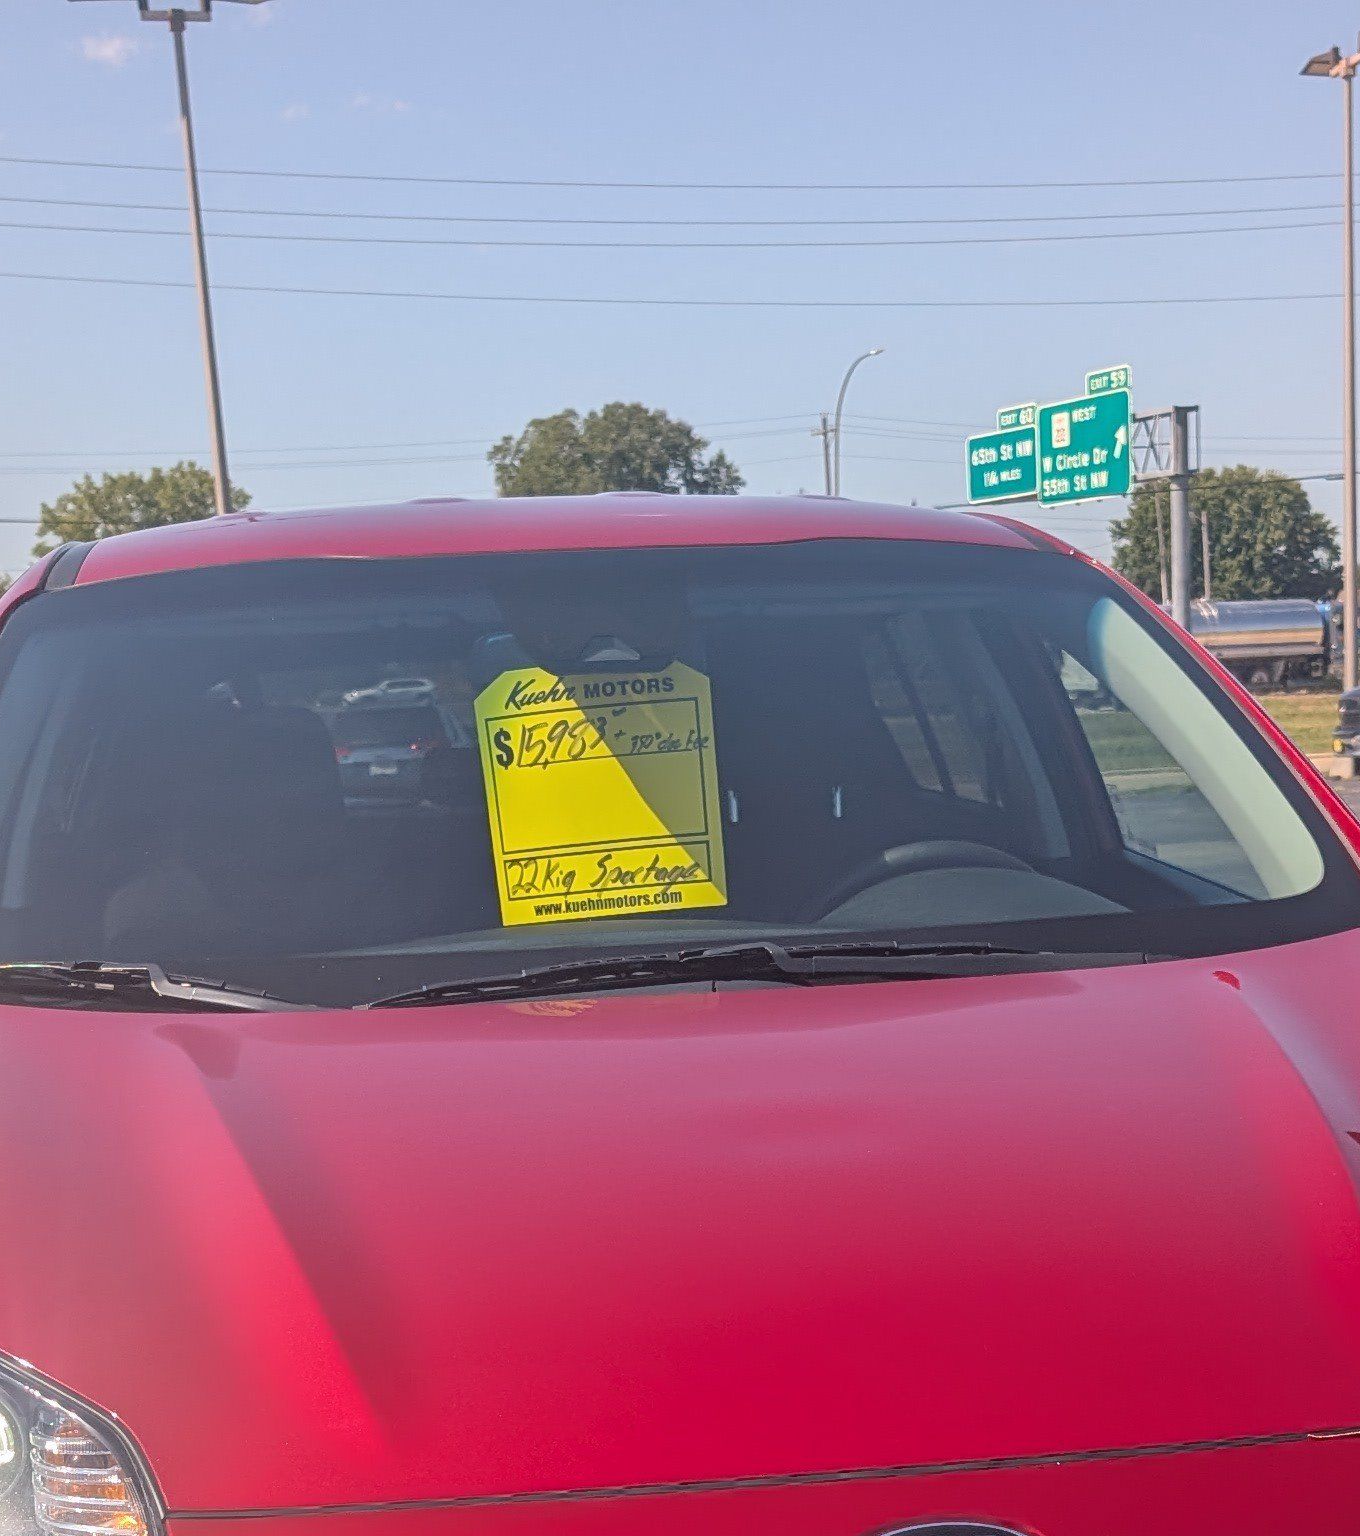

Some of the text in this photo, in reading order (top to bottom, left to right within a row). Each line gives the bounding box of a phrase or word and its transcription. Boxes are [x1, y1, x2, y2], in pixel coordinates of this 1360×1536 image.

[1090, 370, 1126, 390] EXIT 59
[1072, 405, 1097, 423] WEST
[971, 439, 1033, 466] 65th St NW
[1043, 446, 1108, 473] W Circle Dr
[1042, 470, 1109, 497] 55th St NW
[504, 677, 674, 710] Kuehn MOTORS
[534, 891, 682, 916] www.kuehnmotors.com
